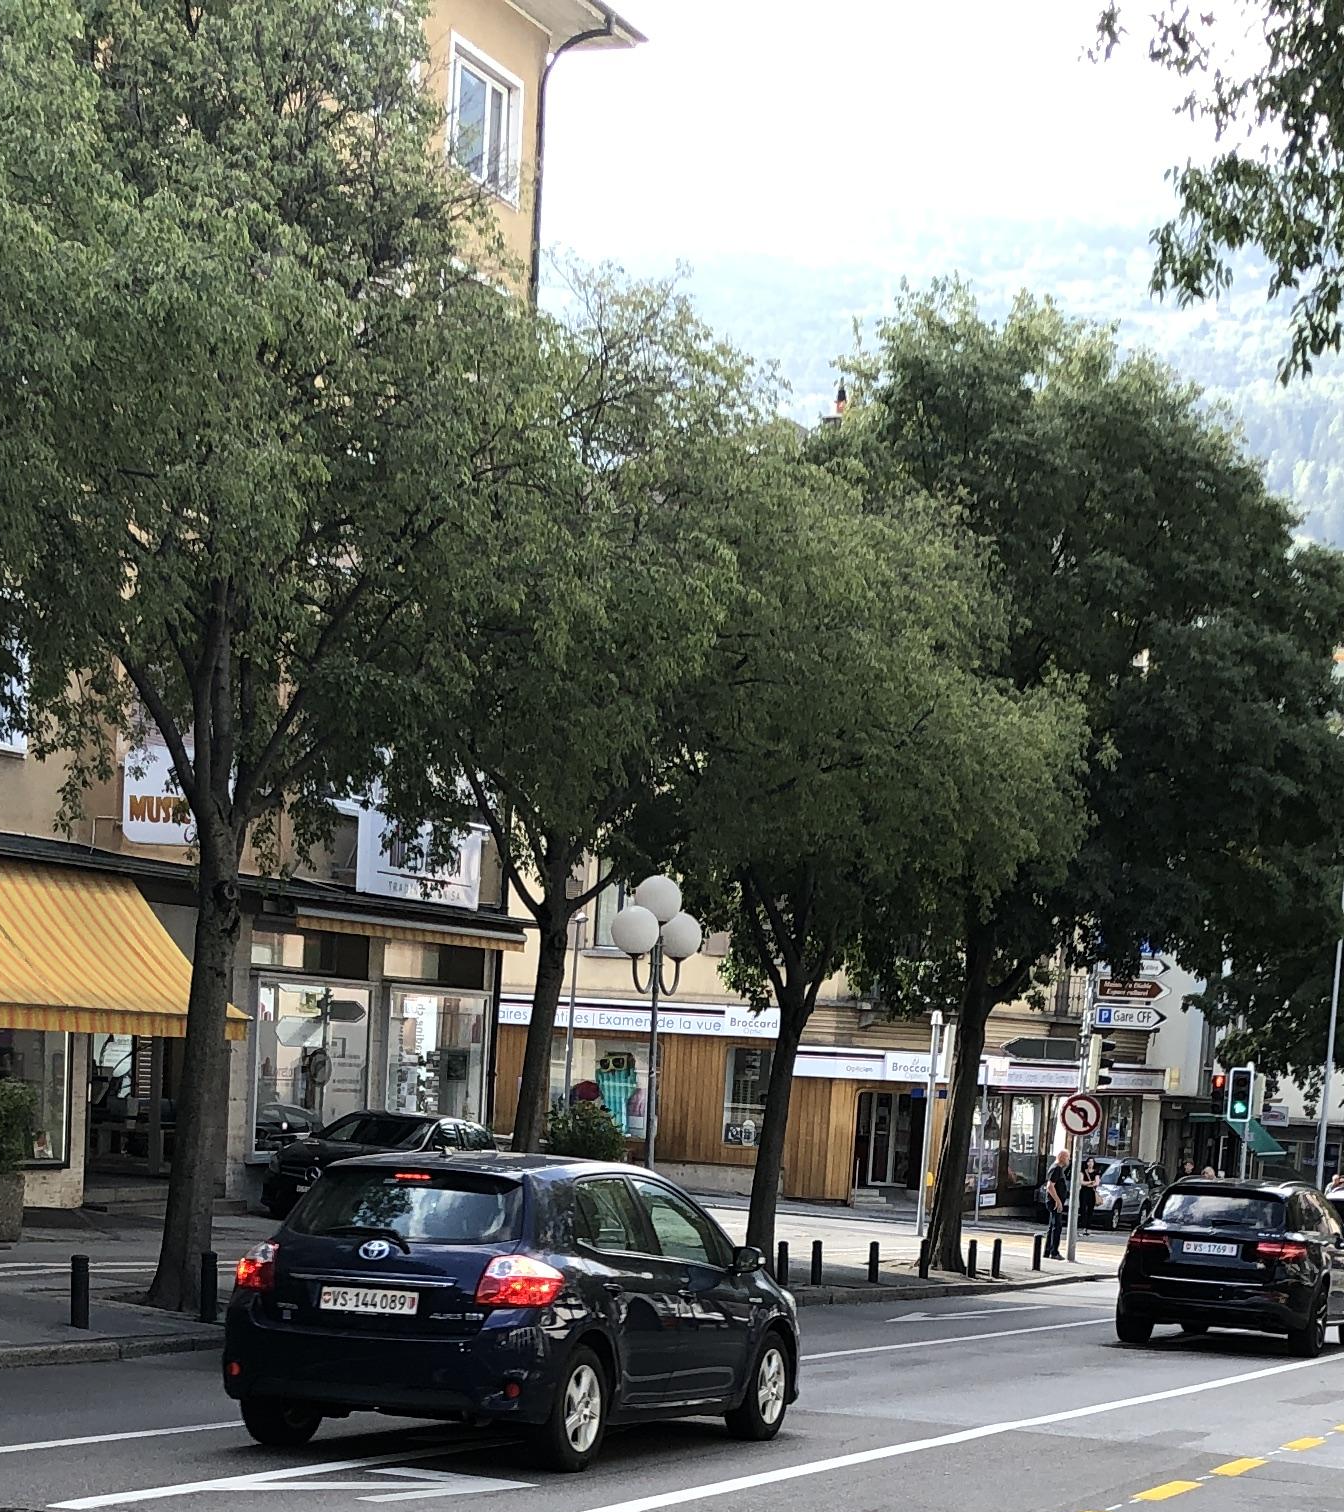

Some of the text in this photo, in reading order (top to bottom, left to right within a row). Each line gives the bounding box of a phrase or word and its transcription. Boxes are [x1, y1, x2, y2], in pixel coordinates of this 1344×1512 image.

[599, 1014, 651, 1028] Examen
[657, 1016, 674, 1029] de
[680, 1017, 692, 1030] la
[697, 1020, 722, 1032] vue
[730, 1017, 778, 1029] Broccard
[1114, 1010, 1134, 1022] Gare
[1137, 1011, 1152, 1023] CFF
